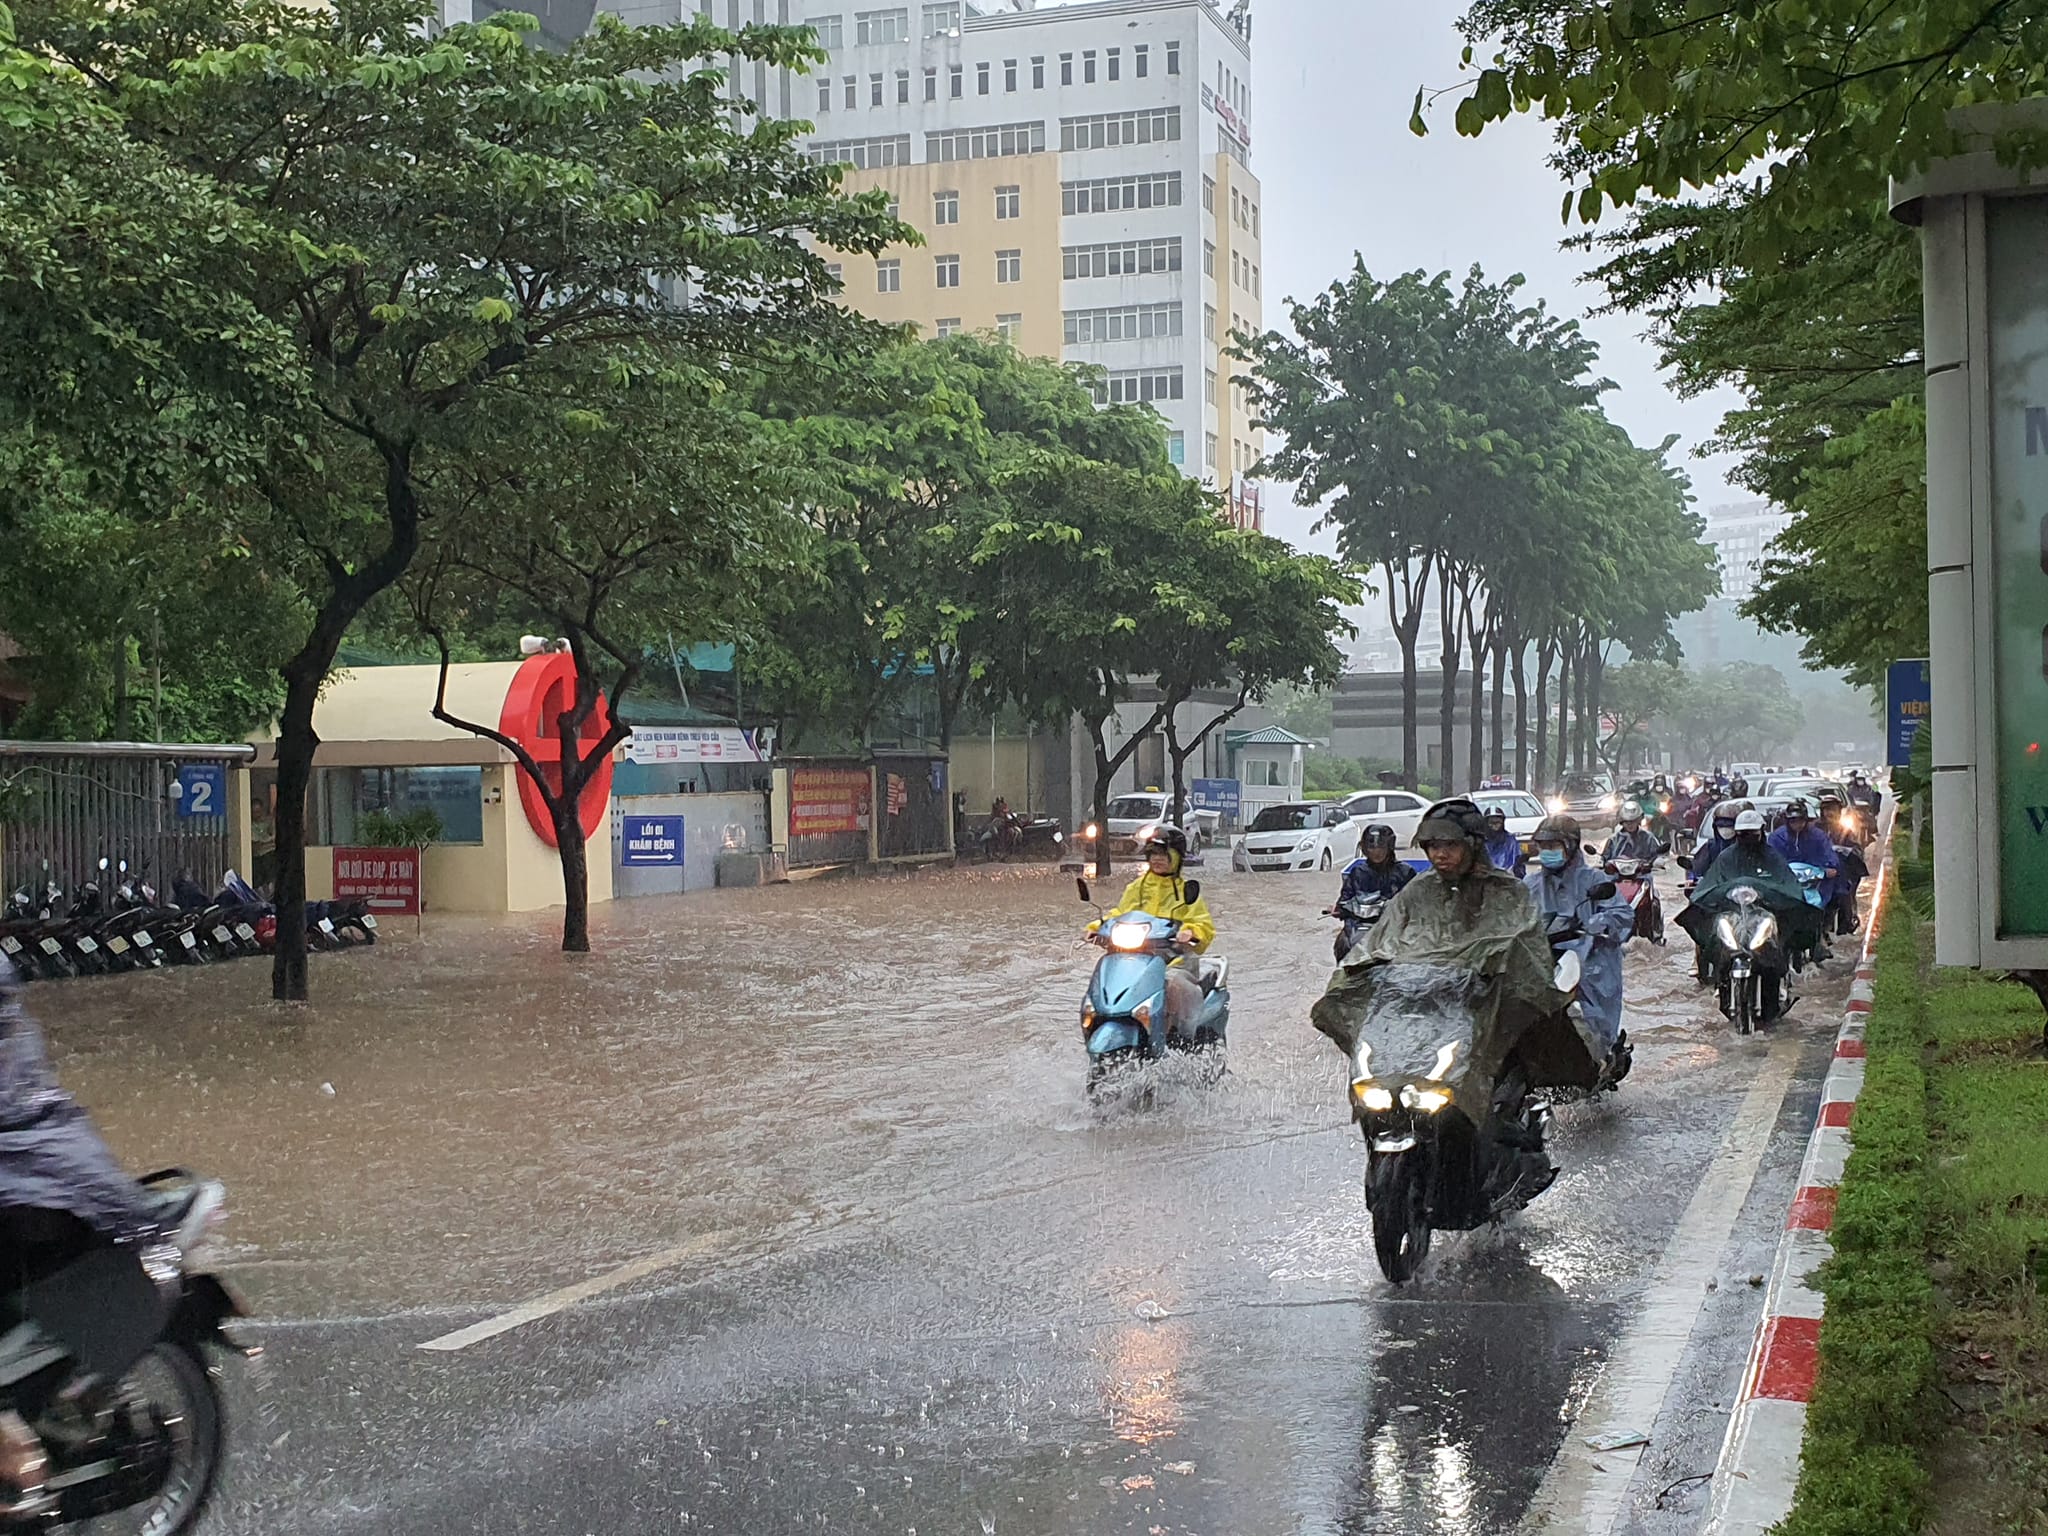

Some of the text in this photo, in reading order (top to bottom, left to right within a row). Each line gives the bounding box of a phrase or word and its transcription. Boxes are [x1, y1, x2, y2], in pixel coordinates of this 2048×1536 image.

[191, 781, 212, 812] 2
[641, 821, 654, 836] LỐI
[629, 838, 675, 852] KHÁM BỆNH
